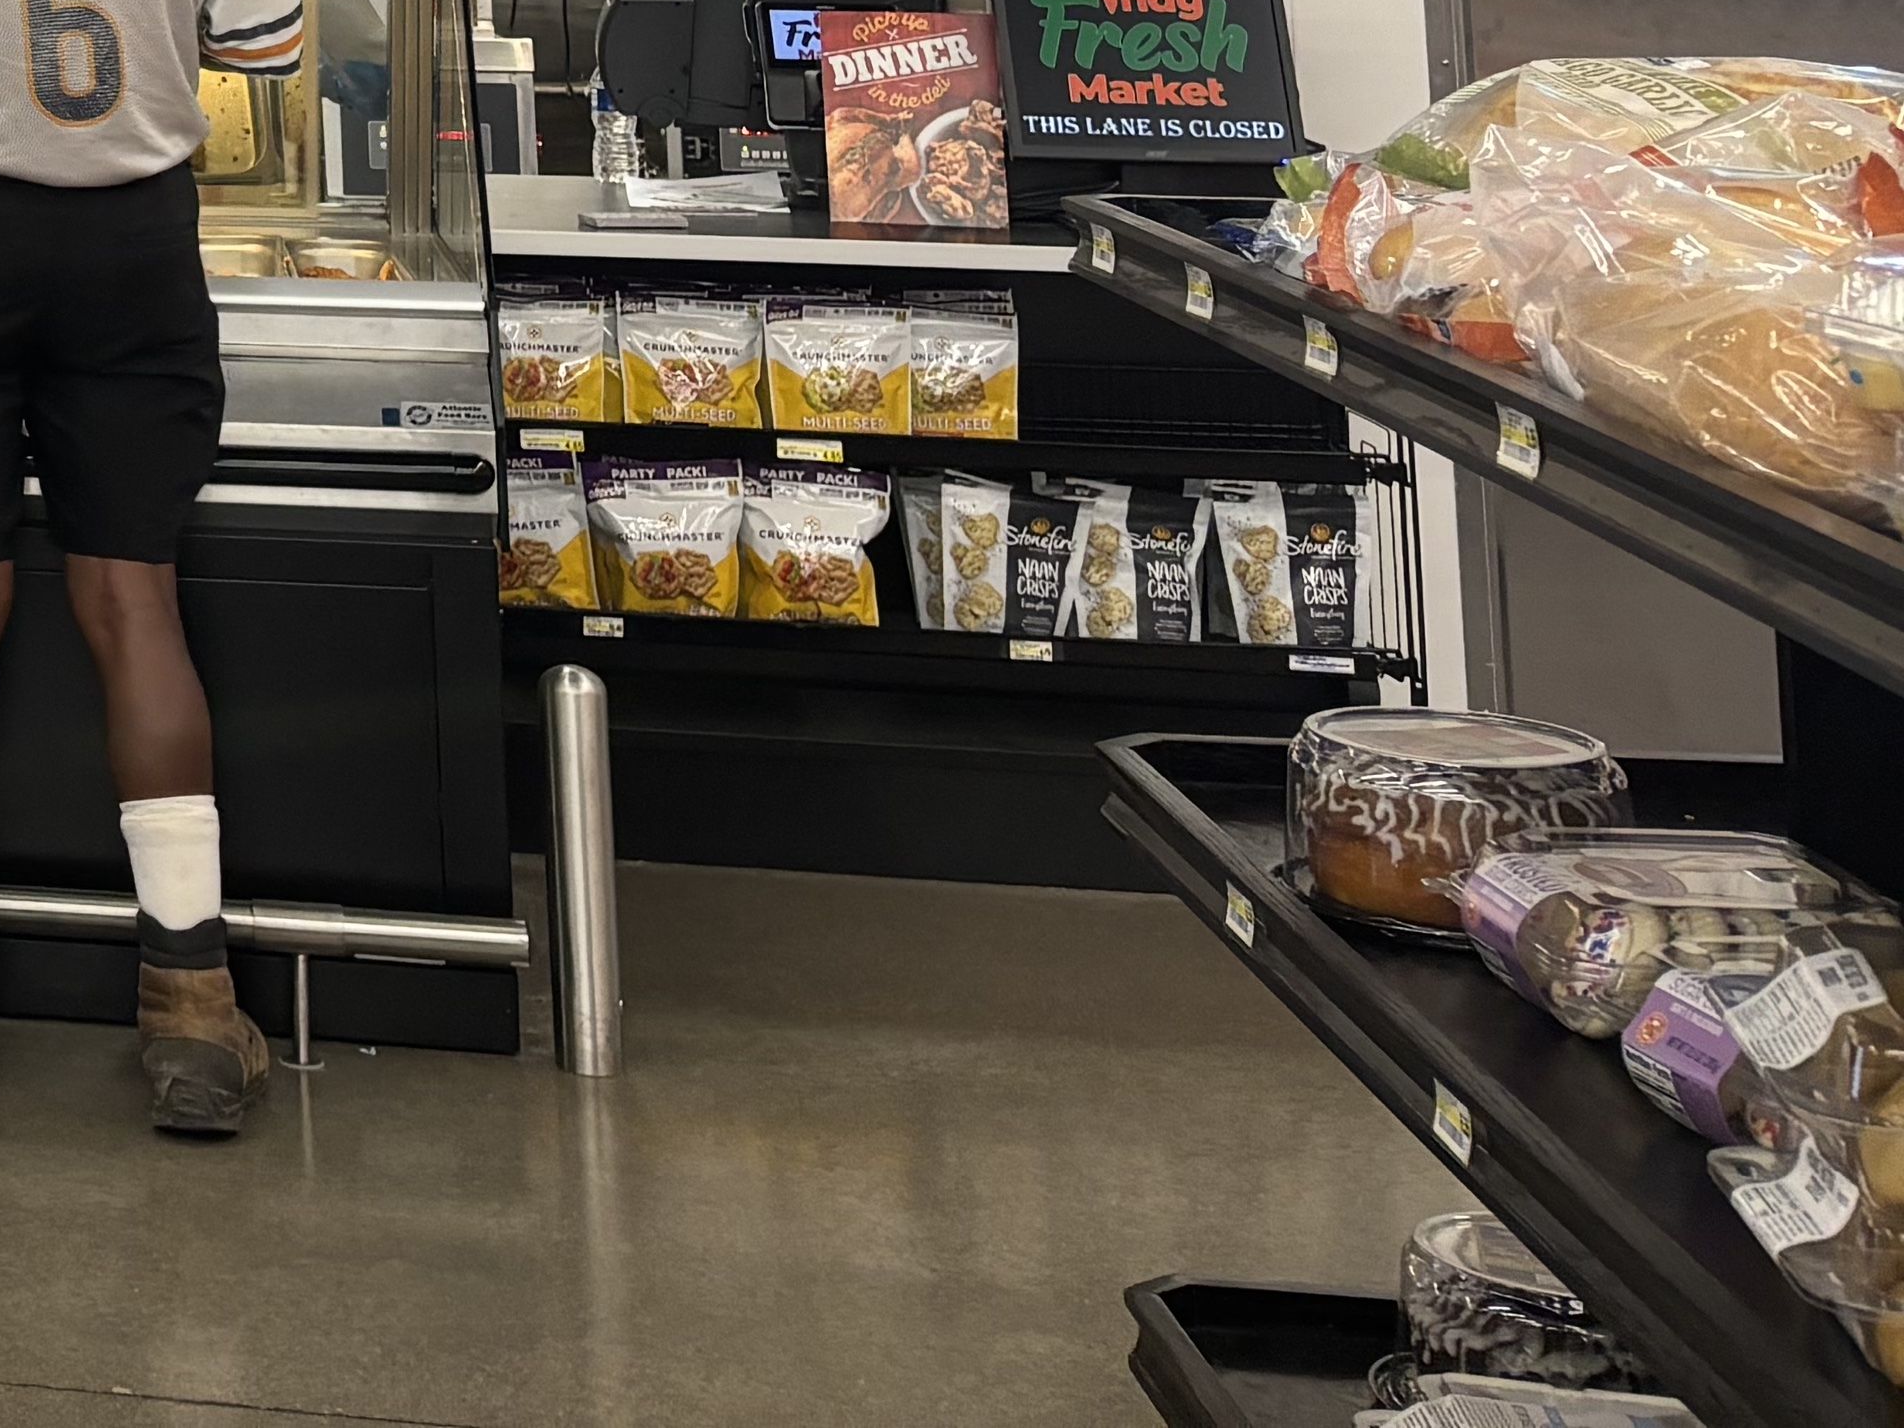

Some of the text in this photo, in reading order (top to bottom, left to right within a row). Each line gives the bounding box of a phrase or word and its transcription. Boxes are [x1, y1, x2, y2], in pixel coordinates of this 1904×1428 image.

[828, 35, 978, 87] DINNER
[1067, 73, 1227, 107] Market
[1023, 114, 1285, 141] THIS LANE IS CLOSED
[802, 415, 887, 432] MULTI-SEED
[611, 467, 655, 481] PARTY
[759, 468, 805, 482] PARTY
[1017, 558, 1060, 580] NAAN
[1146, 561, 1189, 582] NAAN
[1301, 566, 1345, 590] NAAN
[1016, 577, 1059, 600] CRISPS
[1147, 578, 1191, 601] CRISPS
[1303, 585, 1347, 605] CRISPS
